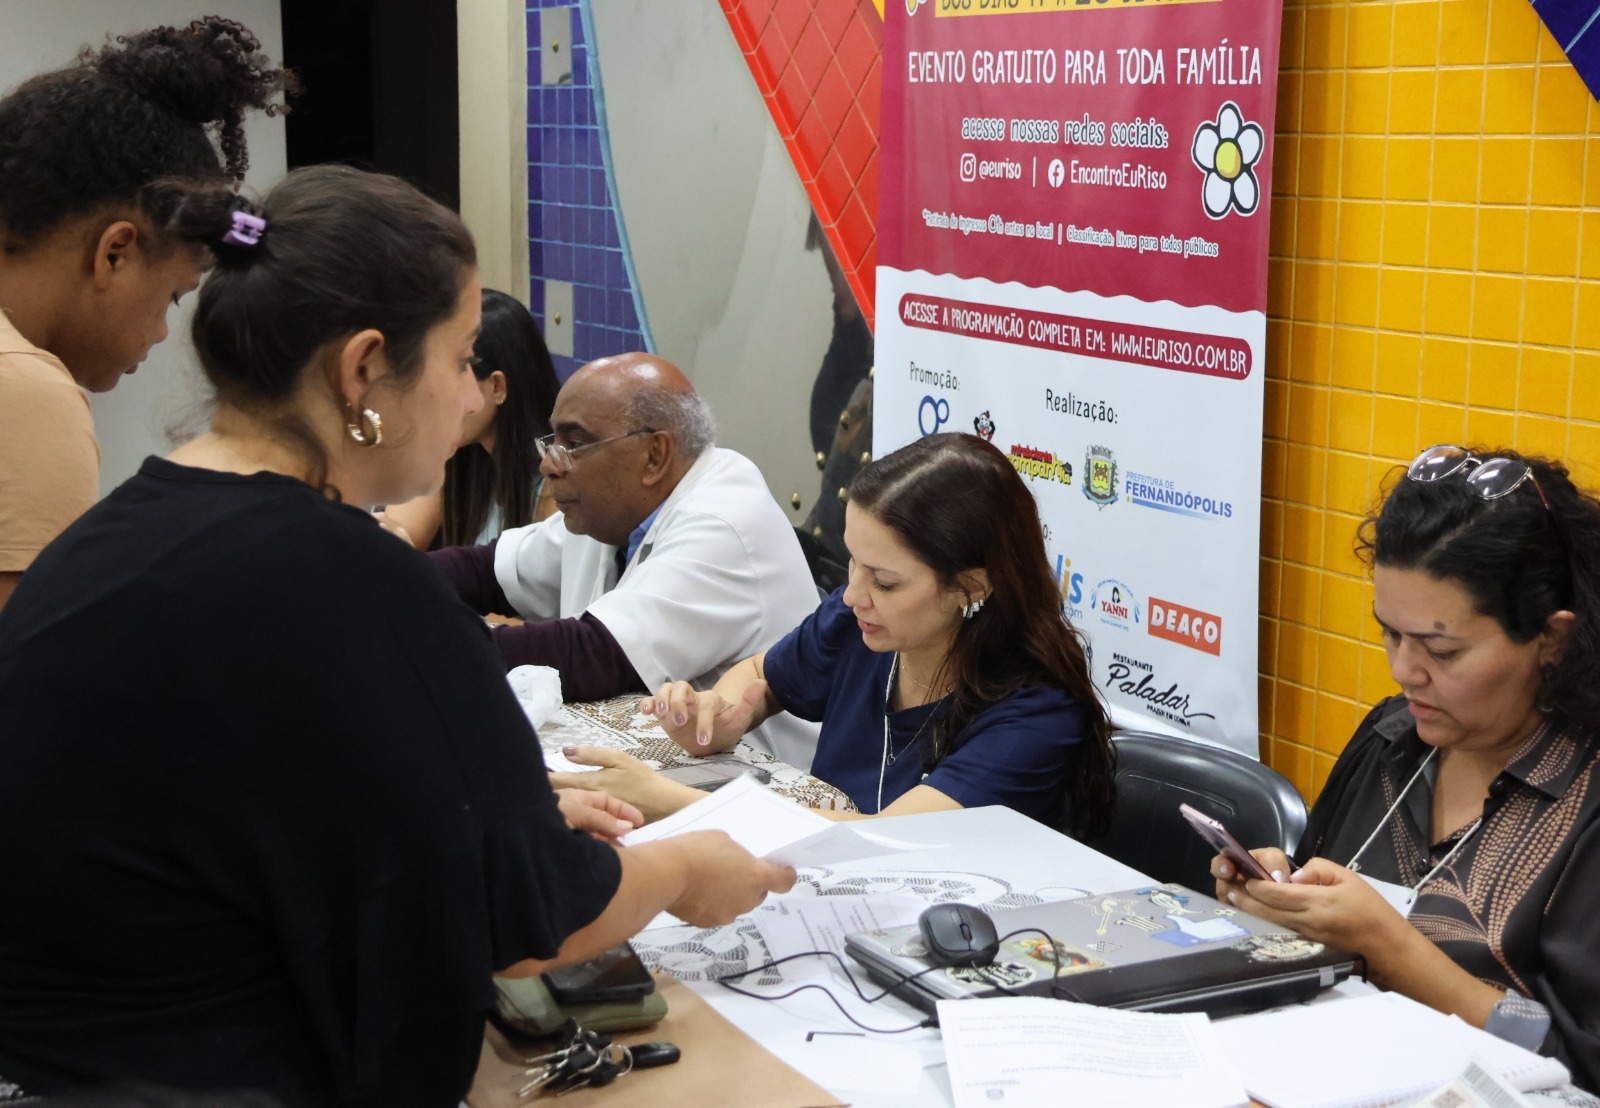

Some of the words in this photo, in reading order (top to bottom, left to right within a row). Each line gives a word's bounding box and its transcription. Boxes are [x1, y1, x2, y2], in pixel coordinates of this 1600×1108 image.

[908, 50, 966, 83] EVENTO
[972, 49, 1057, 84] GRATUITO
[1065, 50, 1106, 85] PARA
[1117, 48, 1165, 84] TODA
[1177, 38, 1261, 85] FAMÍLIA
[962, 117, 1005, 140] acesse
[1010, 119, 1059, 143] nossas
[1065, 113, 1105, 146] redes
[1111, 117, 1169, 148] sociais:
[979, 158, 1022, 180] @euriso
[1071, 160, 1168, 189] EncontroEuRiso
[1005, 221, 1025, 238] antes
[1025, 223, 1036, 238] no
[1036, 221, 1054, 240] local
[1116, 229, 1137, 249] Livre
[1139, 235, 1159, 254] para
[1160, 234, 1183, 254] todos
[1184, 236, 1219, 259] públicos
[904, 301, 939, 325] ACESSE
[942, 307, 949, 326] A
[951, 308, 1024, 338] PROGRAMAÇÃO
[1028, 319, 1081, 348] COMPLETA
[1086, 328, 1106, 352] EM:
[1111, 332, 1247, 375] WWW.EURISO.COM.BR
[910, 361, 960, 391] Promoção:
[1046, 388, 1118, 424] Realização:
[1126, 471, 1163, 488] PREFEITURA
[1165, 480, 1174, 490] DE
[1126, 480, 1232, 518] FERNANDÓPOLIS
[1101, 600, 1128, 619] YANNI
[1151, 604, 1218, 644] DEAÇO
[1113, 652, 1153, 672] RESTAURANTE
[1106, 663, 1215, 720] Paladar
